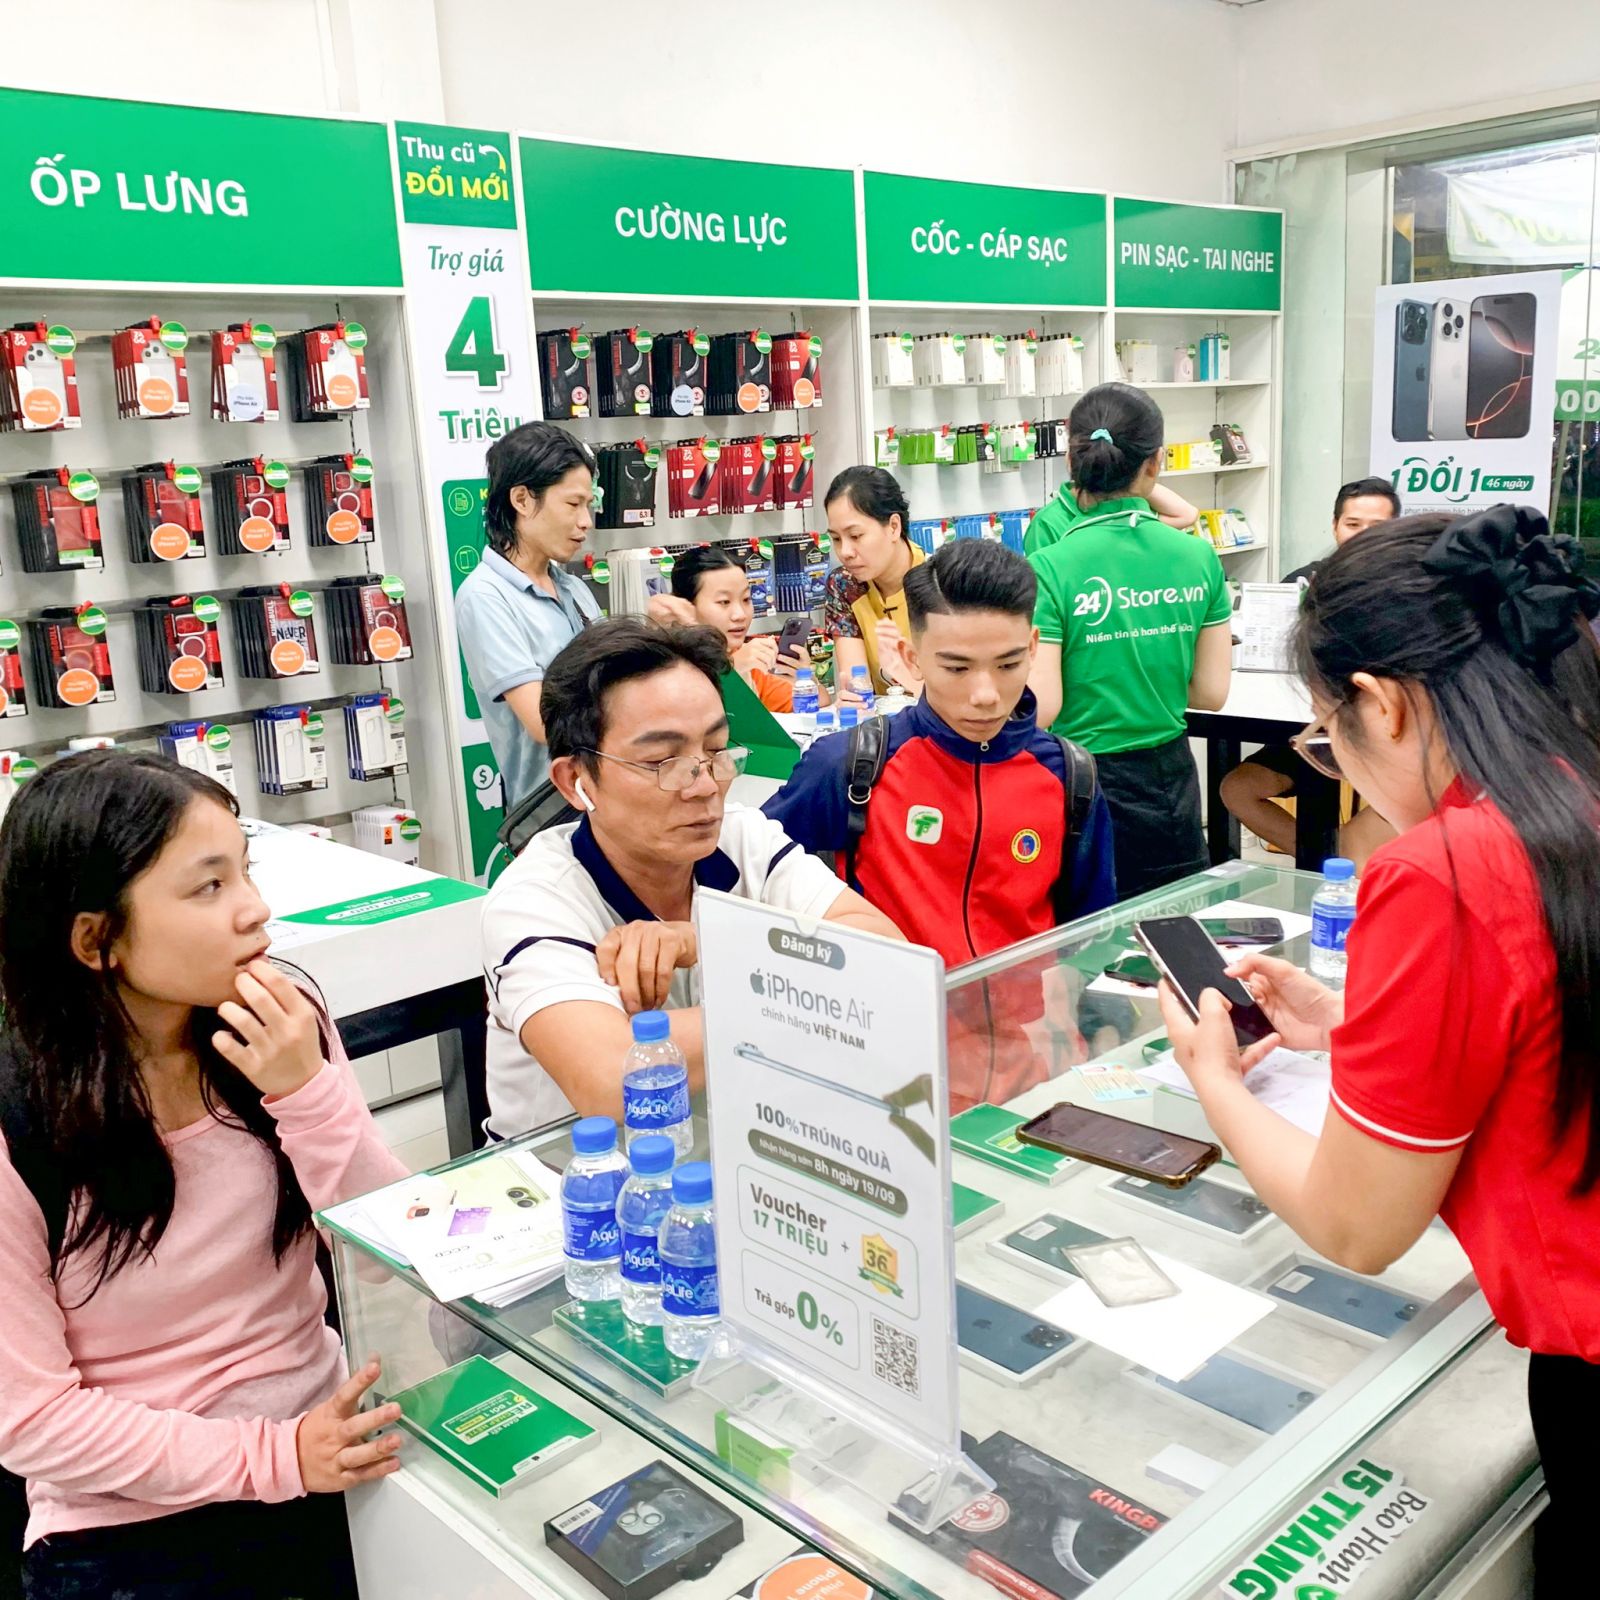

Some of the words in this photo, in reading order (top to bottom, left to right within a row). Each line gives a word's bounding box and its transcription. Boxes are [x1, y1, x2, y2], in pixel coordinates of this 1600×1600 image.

[401, 135, 444, 161] Thu
[450, 142, 475, 163] cũ
[30, 153, 101, 207] ỐP
[115, 170, 249, 217] LƯNG
[405, 165, 454, 197] ĐỔI
[461, 172, 509, 201] MỚI
[614, 201, 726, 243] CƯỜNG
[733, 212, 788, 252] LỰC
[911, 219, 961, 256] CỐC
[979, 227, 1023, 259] CÁP
[1027, 235, 1068, 268] SẠC
[428, 245, 463, 276] Trợ
[467, 248, 505, 278] giá
[1121, 242, 1150, 266] PIN
[1155, 244, 1189, 273] SẠC
[1203, 247, 1227, 271] TAI
[1231, 249, 1275, 273] NGHE
[445, 296, 506, 387] 4
[1391, 468, 1401, 492] 1
[1407, 456, 1463, 493] ĐỔI
[1470, 468, 1481, 492] 1
[1486, 478, 1500, 488] 46
[1503, 480, 1529, 490] ngày
[1115, 630, 1129, 639] tin
[781, 935, 814, 958] Đăng
[816, 943, 832, 963] ký
[767, 973, 842, 1020] iPhone
[846, 998, 874, 1030] Air
[761, 1006, 786, 1023] chính
[787, 1016, 811, 1034] hãng
[812, 1022, 837, 1041] VIỆT
[840, 1032, 865, 1050] NAM
[627, 1104, 668, 1115] AquaLife
[857, 1145, 891, 1173] QUÀ
[815, 1159, 829, 1175] 8h
[832, 1169, 859, 1191] ngày
[863, 1179, 896, 1205] 19/09
[750, 1183, 827, 1232] Voucher
[754, 1210, 770, 1228] 17
[775, 1218, 829, 1256] TRIỆU
[866, 1249, 889, 1272] 36
[754, 1288, 772, 1307] Trả
[774, 1302, 796, 1319] góp
[797, 1290, 844, 1346] 0%
[1342, 1459, 1394, 1498] 15
[1376, 1490, 1428, 1530] Bảo
[1229, 1491, 1366, 1600] THÁNG
[1318, 1527, 1389, 1585] Hành
[796, 1567, 840, 1596] iPhone
